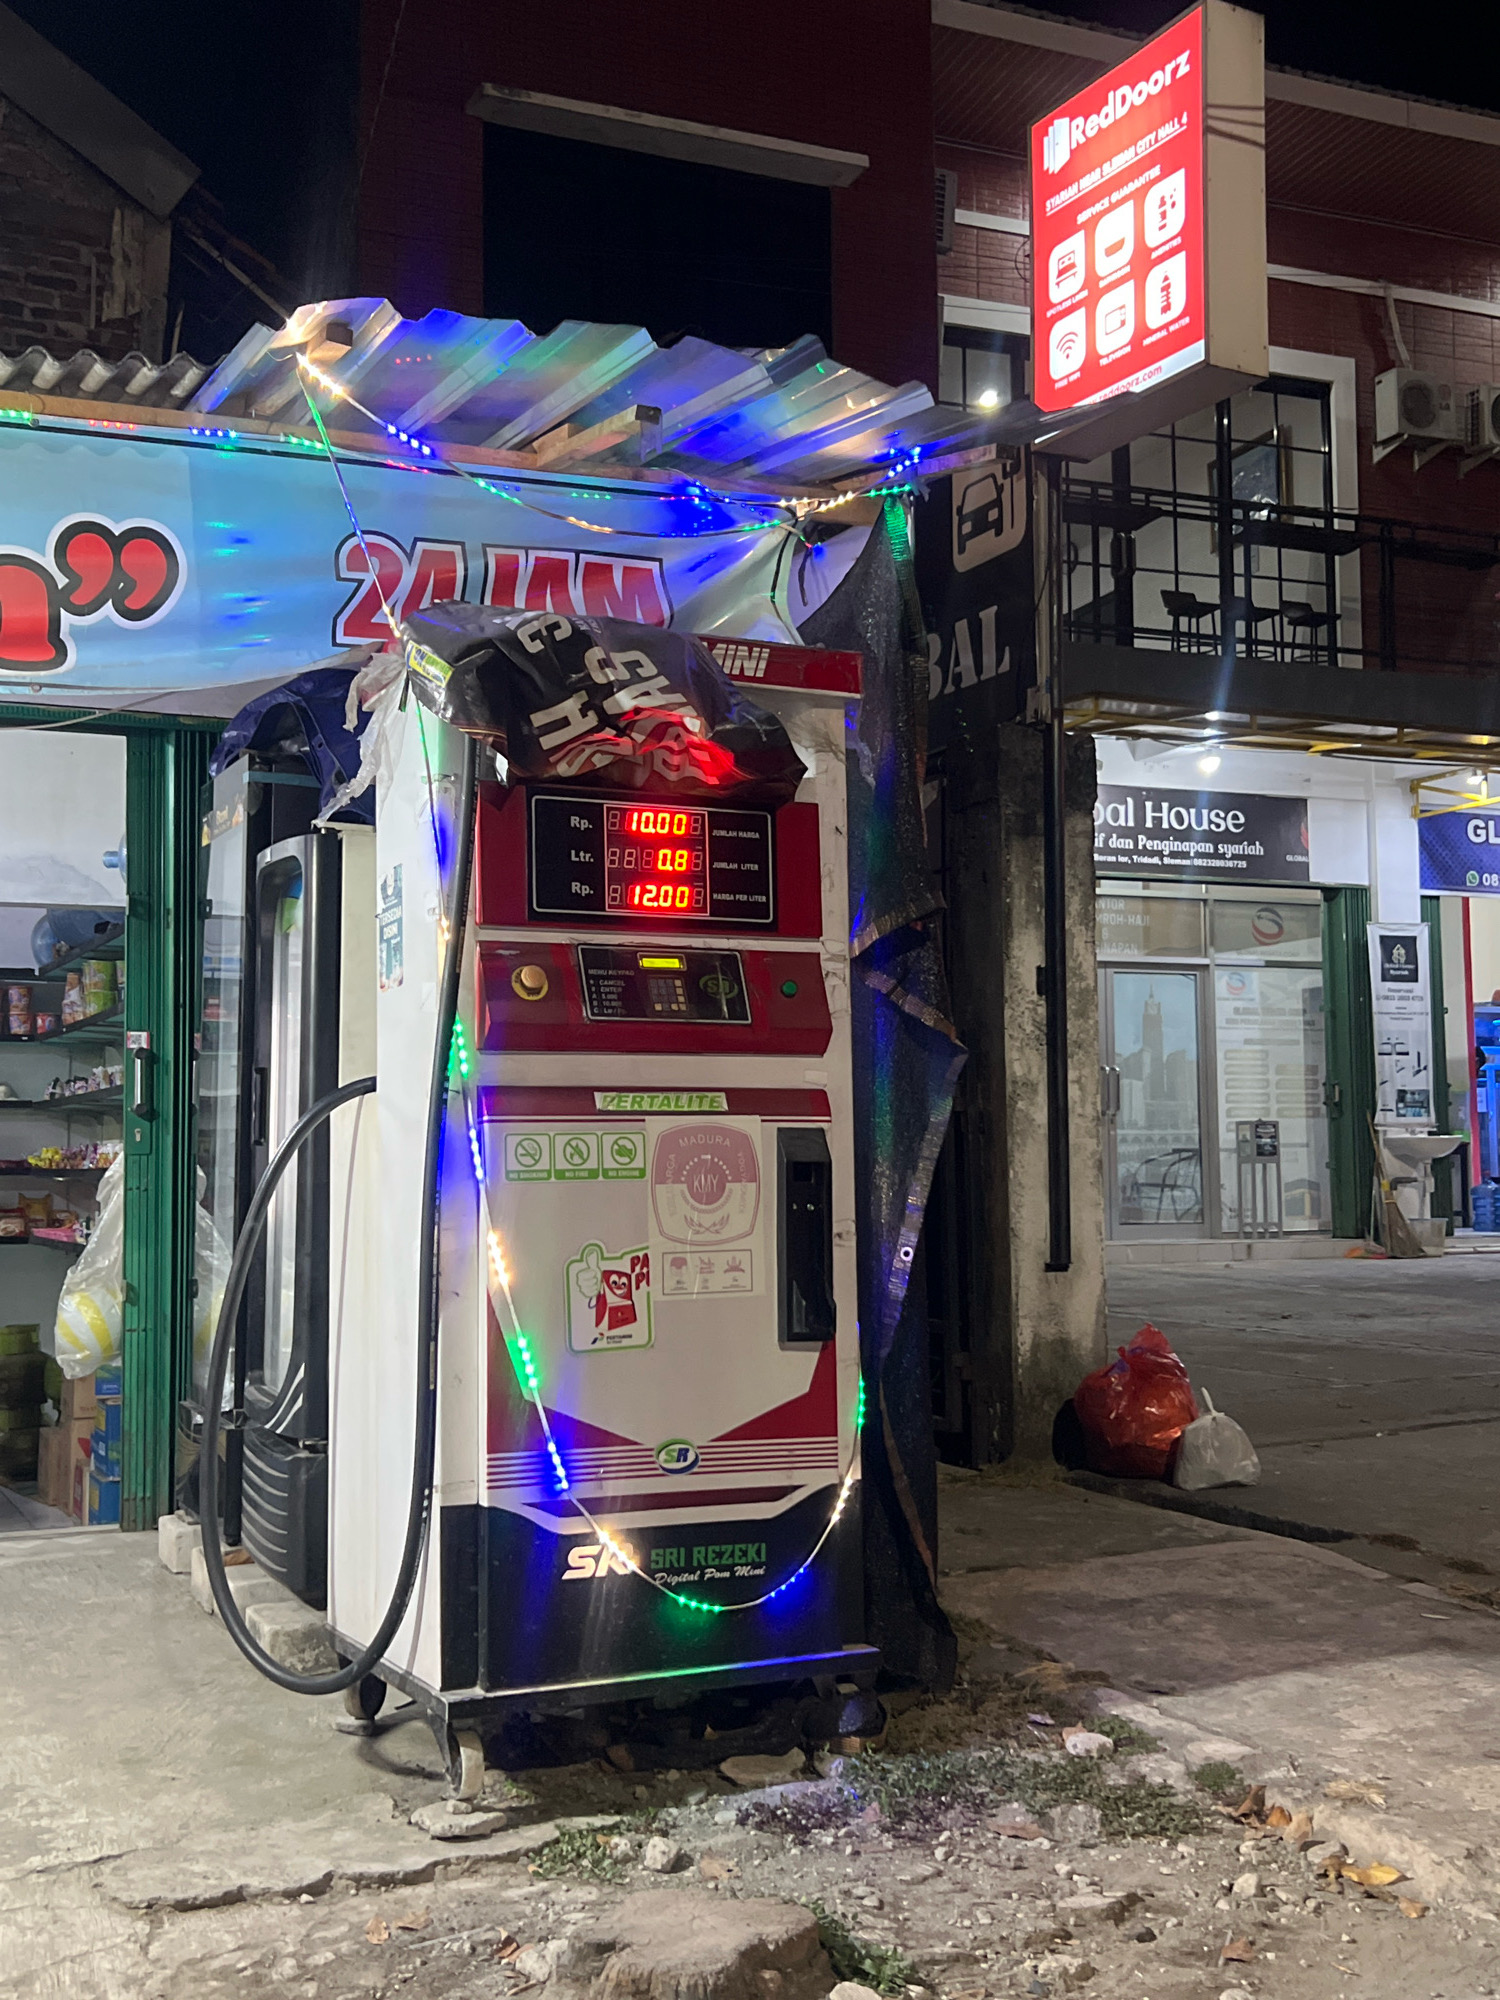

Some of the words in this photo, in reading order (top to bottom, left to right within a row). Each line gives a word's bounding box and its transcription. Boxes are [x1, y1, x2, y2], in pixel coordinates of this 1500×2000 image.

[1071, 49, 1190, 150] RedDoorz
[1136, 130, 1157, 155] CITY
[1076, 196, 1110, 225] SERVICE
[1110, 164, 1161, 204] GUARANTEE
[1168, 316, 1190, 333] WATER
[570, 815, 594, 831] Rp.
[1144, 800, 1246, 834] House
[711, 829, 738, 839] JUMLAH
[738, 830, 760, 840] HARGA
[1108, 834, 1134, 850] dan
[1138, 834, 1214, 858] Penginapan
[1217, 841, 1265, 859] syariah
[570, 849, 595, 863] Ltr.
[712, 861, 738, 871] JUMLAH
[740, 862, 759, 871] LITER
[571, 881, 595, 896] Rp.
[712, 892, 735, 902] HARGA
[735, 893, 748, 902] PER
[748, 894, 767, 904] LITER
[600, 1093, 723, 1111] PERTALITE
[679, 1134, 731, 1148] MADURA
[520, 1171, 548, 1179] SMOKING
[575, 1170, 589, 1178] FIRE
[608, 1169, 617, 1177] NO
[618, 1169, 640, 1177] ENGINE
[693, 1173, 719, 1193] KMY
[663, 1447, 691, 1464] SR
[650, 1547, 686, 1570] SRI
[692, 1542, 768, 1567] REZEKI
[653, 1570, 702, 1587] Digital
[703, 1568, 732, 1582] Pom
[734, 1565, 767, 1577] Mini
